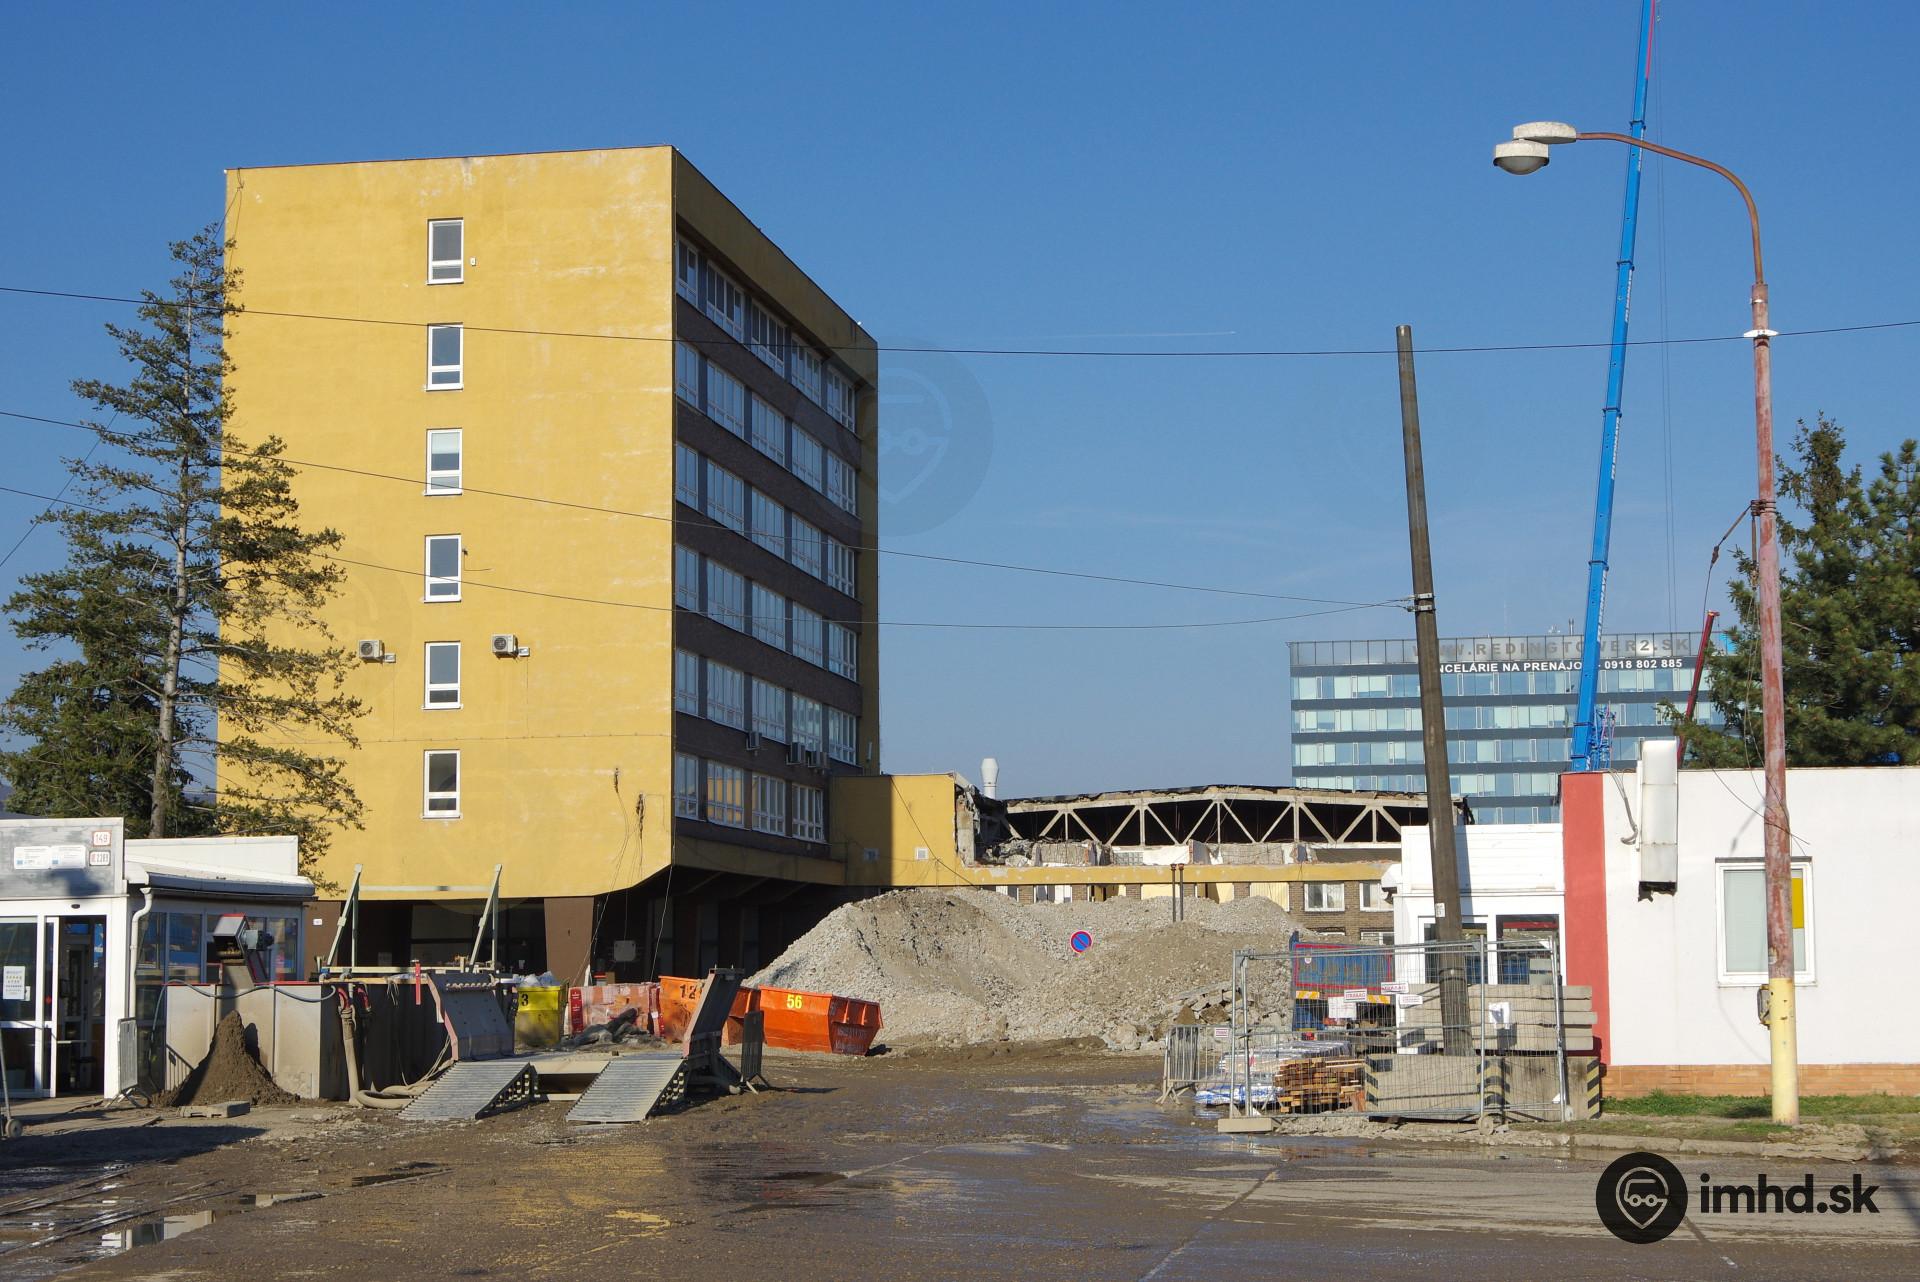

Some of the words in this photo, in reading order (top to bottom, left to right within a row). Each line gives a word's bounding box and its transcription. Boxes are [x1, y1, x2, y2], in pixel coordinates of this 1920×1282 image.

[1440, 661, 1498, 673] NCELÁRIE
[1502, 662, 1520, 672] NA
[1523, 660, 1582, 671] PRENÁJO
[1604, 660, 1632, 669] 0918
[1636, 659, 1657, 668] 802
[1661, 659, 1682, 668] 885
[521, 993, 529, 1006] 3
[786, 993, 802, 1009] 56
